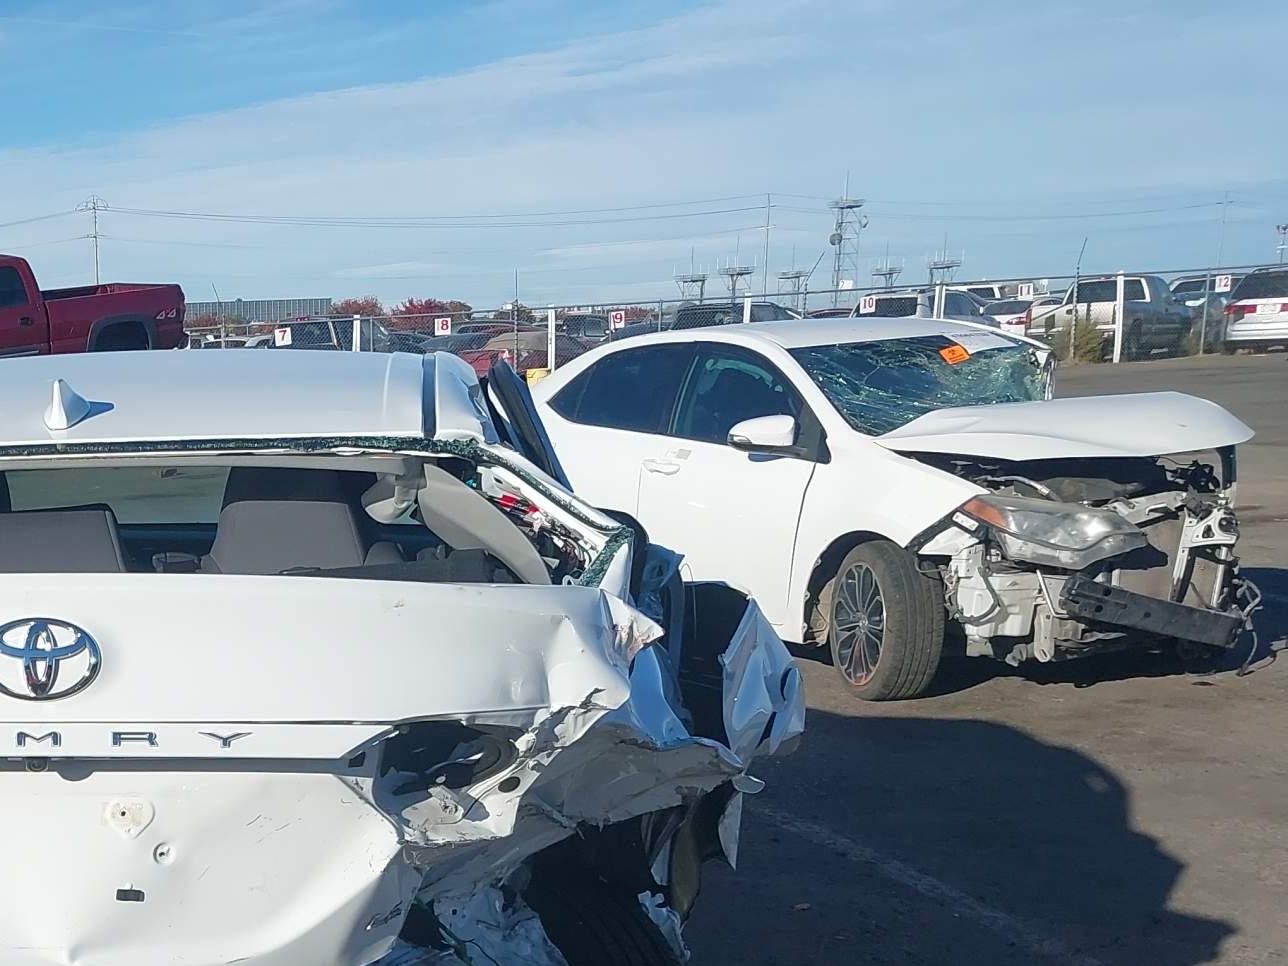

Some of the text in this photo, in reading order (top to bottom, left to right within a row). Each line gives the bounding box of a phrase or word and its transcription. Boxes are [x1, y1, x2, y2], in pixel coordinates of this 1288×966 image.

[863, 297, 874, 309] 10
[614, 312, 623, 324] 9
[440, 319, 450, 331] 8
[278, 329, 288, 342] 7
